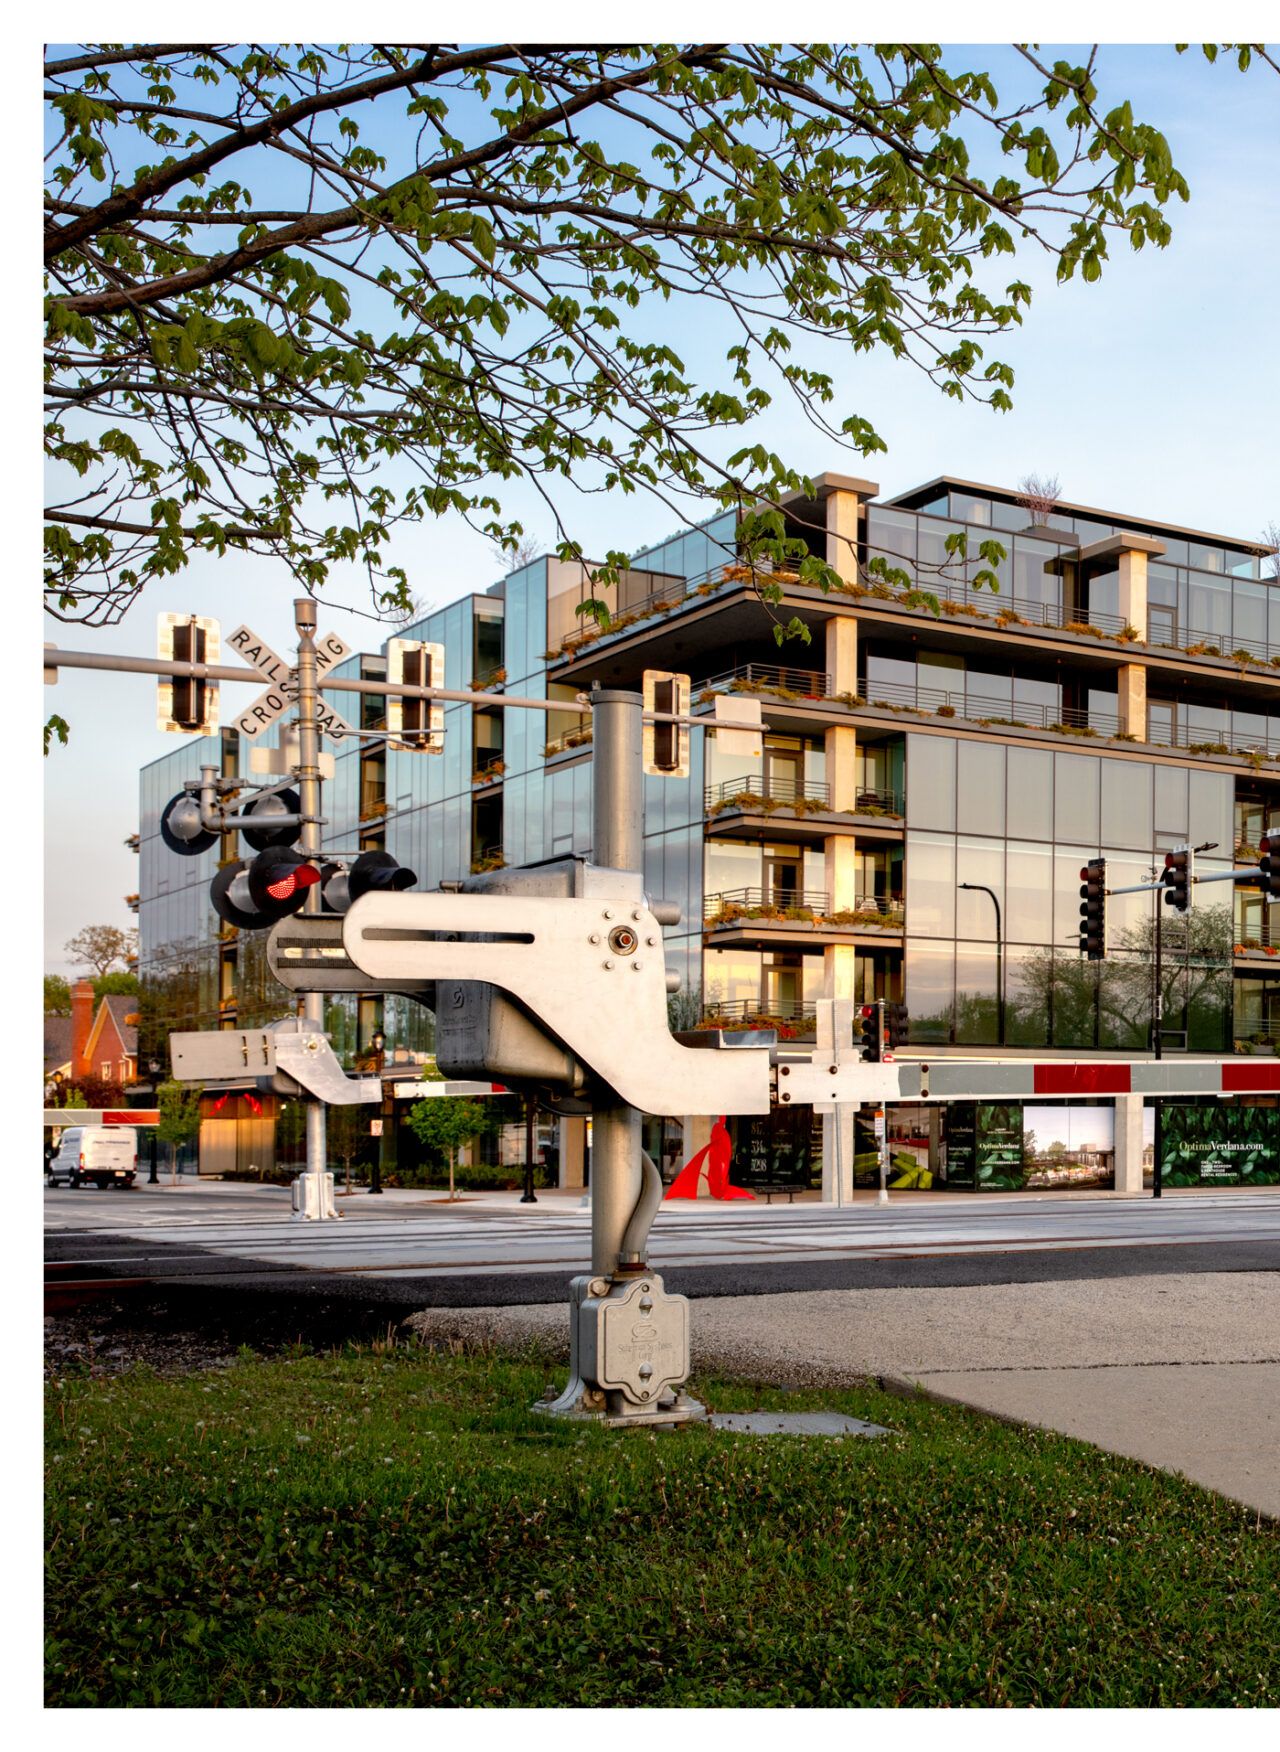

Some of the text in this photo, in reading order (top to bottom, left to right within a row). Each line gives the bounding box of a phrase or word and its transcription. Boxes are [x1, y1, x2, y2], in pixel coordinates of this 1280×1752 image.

[231, 630, 280, 682] RAIL
[240, 639, 343, 735] CROSNG
[1179, 1140, 1264, 1152] OptimaVerdana.com
